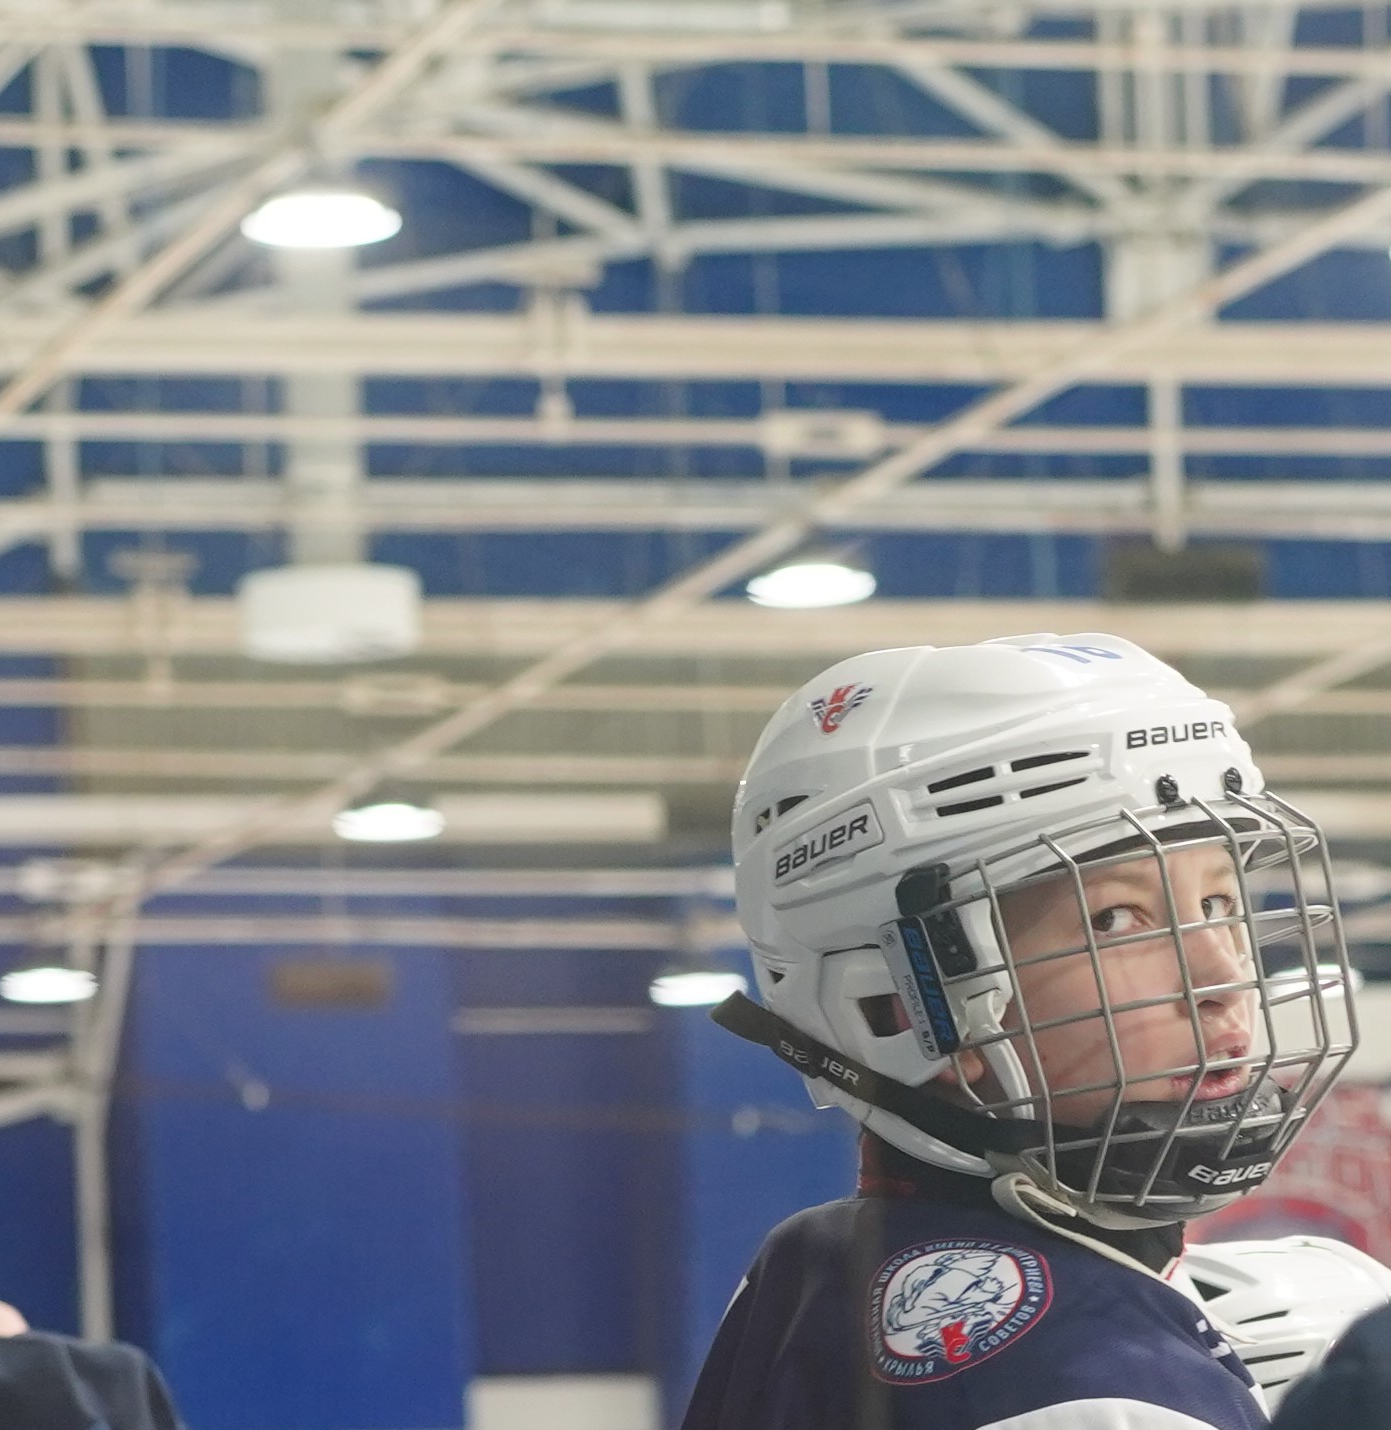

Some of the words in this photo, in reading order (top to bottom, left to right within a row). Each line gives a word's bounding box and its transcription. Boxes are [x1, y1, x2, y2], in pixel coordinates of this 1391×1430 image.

[1126, 721, 1227, 749] BAUER
[775, 815, 868, 879] BAUER
[1187, 1162, 1272, 1186] BAUE
[978, 1304, 1037, 1352] СОВЕТОВ
